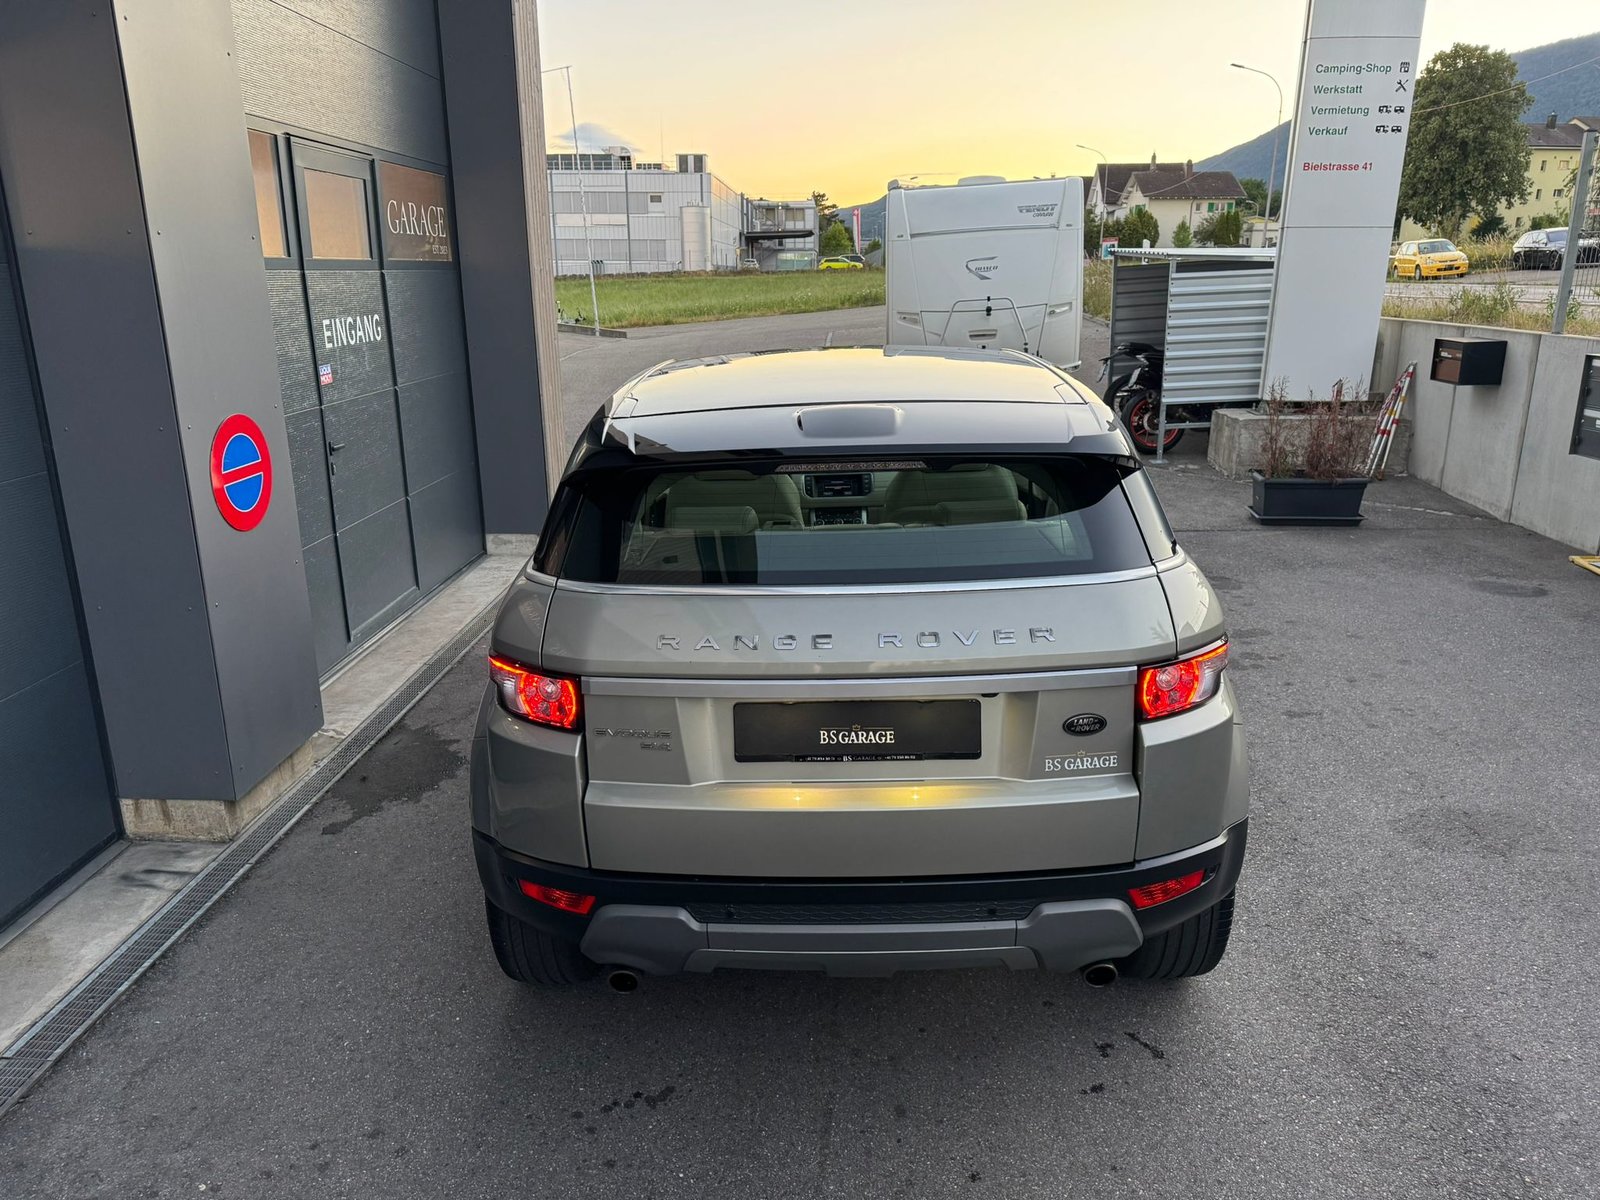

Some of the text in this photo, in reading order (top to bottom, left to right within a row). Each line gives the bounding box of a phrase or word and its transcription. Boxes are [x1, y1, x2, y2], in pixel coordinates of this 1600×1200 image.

[1315, 63, 1392, 75] Camping-Shop
[1313, 84, 1363, 95] Werkstatt
[1310, 105, 1370, 117] Vermietung
[1307, 126, 1348, 136] Verkauf
[1302, 162, 1373, 172] Bielstrasse 41
[387, 199, 447, 238] GARAGE
[322, 313, 382, 349] EINGANG
[656, 627, 1057, 651] RANGE ROVER
[1073, 717, 1094, 726] LAND
[1075, 723, 1100, 732] ROVER
[594, 728, 672, 739] EVOQUE
[820, 730, 895, 744] BS GARAGE
[1045, 755, 1118, 772] BS GARAGE
